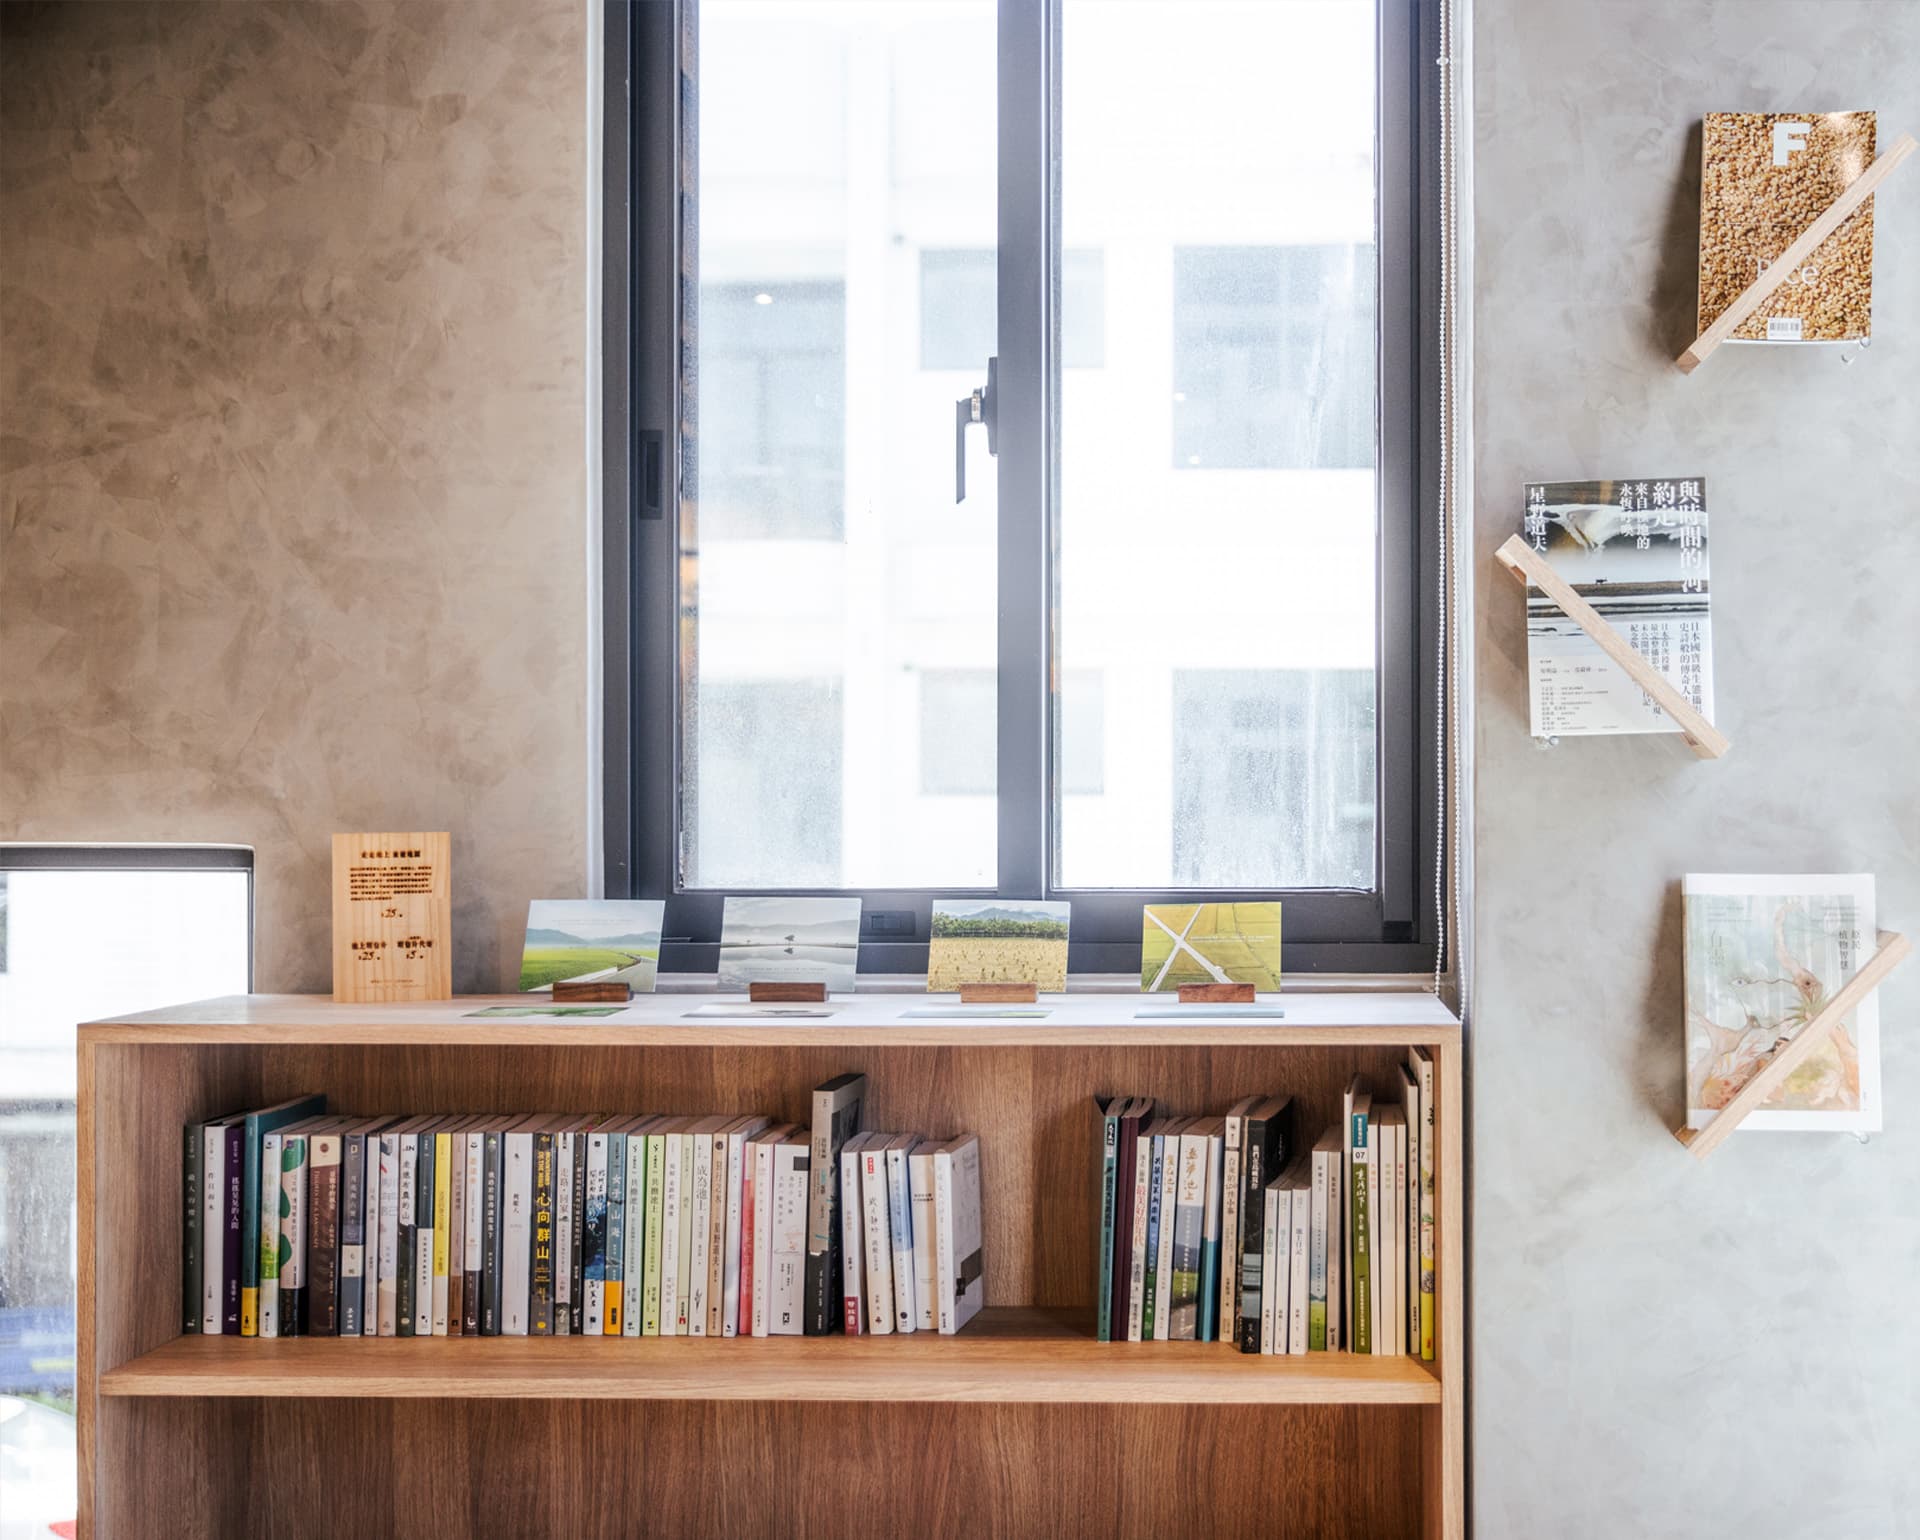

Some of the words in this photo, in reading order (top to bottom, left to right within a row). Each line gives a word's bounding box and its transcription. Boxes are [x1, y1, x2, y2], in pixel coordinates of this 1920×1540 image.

[1774, 123, 1810, 166] F
[1757, 257, 1819, 285] Rce
[1530, 486, 1547, 552] 星野道夫
[1679, 481, 1702, 593] 與時間的河
[536, 1192, 551, 1259] 心向群山
[611, 1174, 621, 1237] 女子山海
